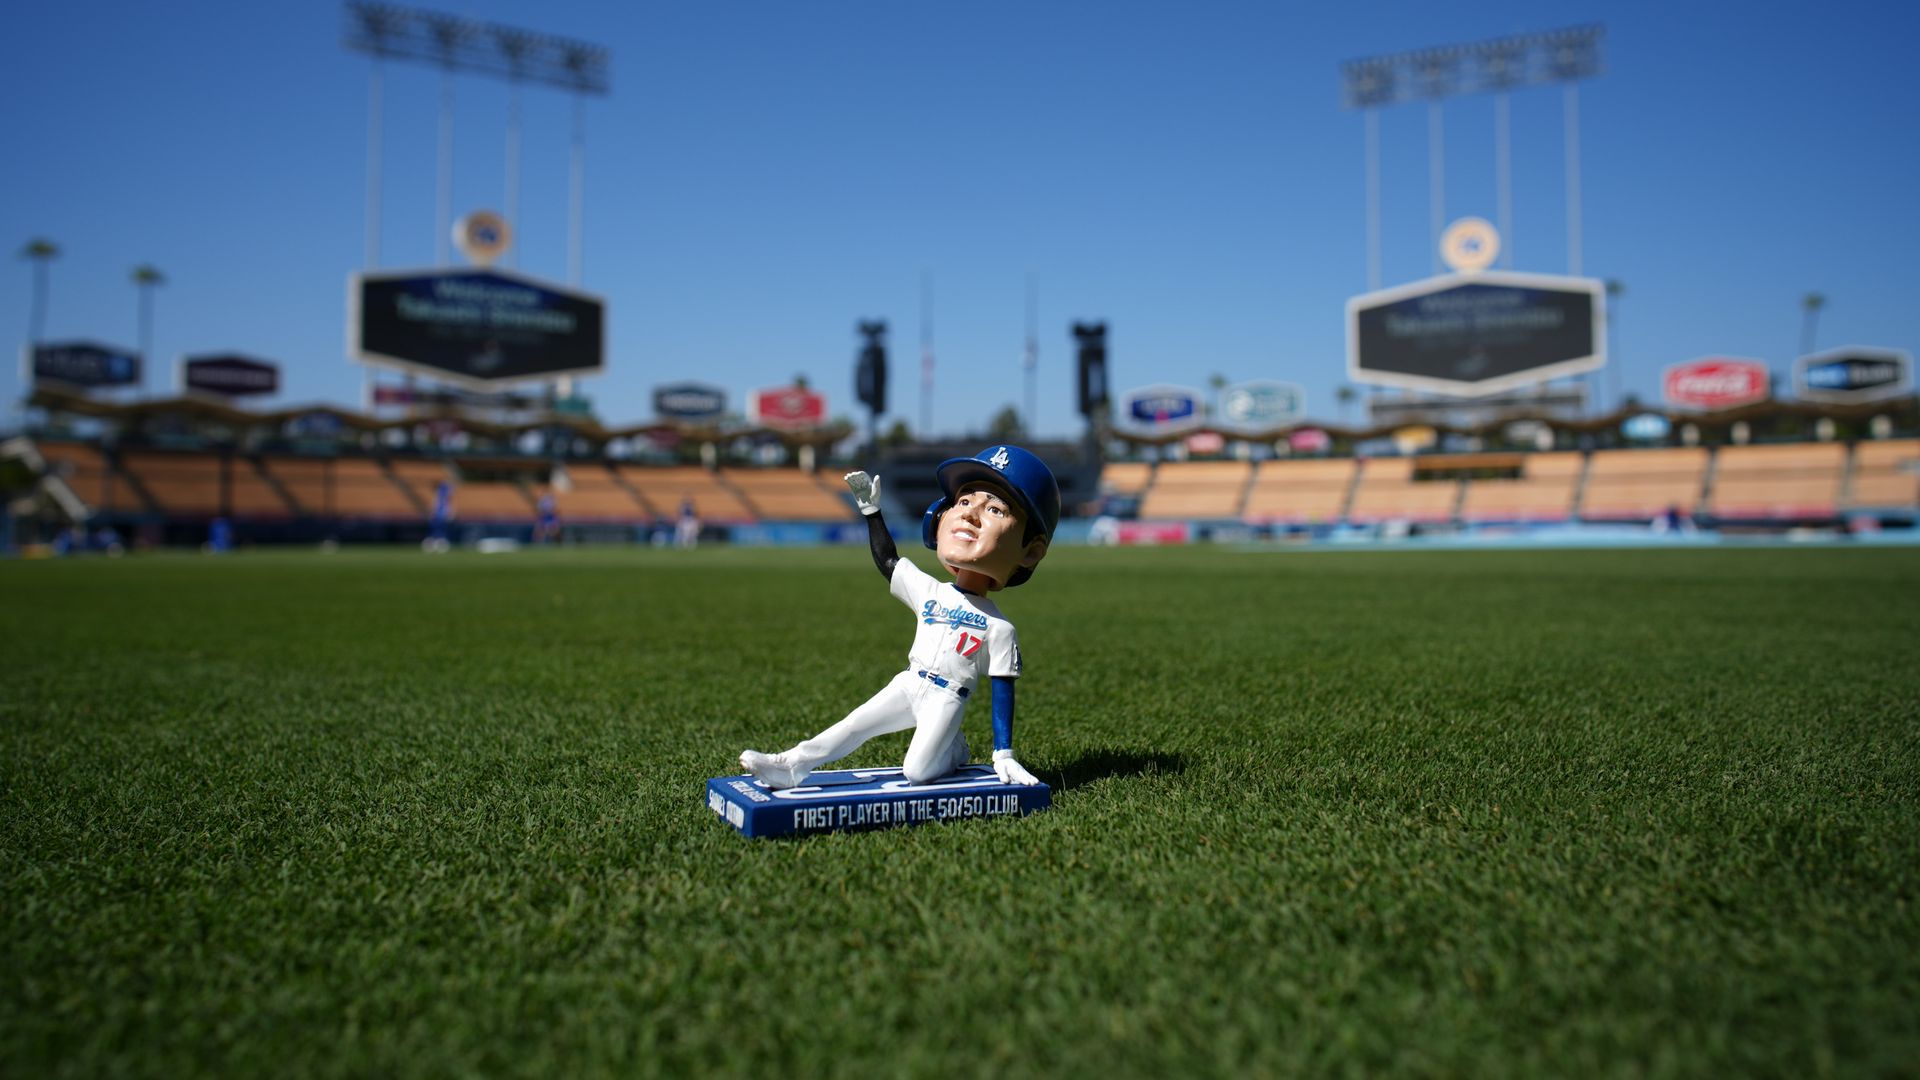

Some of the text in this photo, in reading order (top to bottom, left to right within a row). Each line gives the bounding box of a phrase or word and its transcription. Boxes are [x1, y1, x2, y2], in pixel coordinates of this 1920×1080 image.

[922, 600, 988, 631] Dodgers
[956, 631, 982, 657] 17
[793, 794, 1019, 829] FIRST PLAYER IN THE 50/50 CLUB
